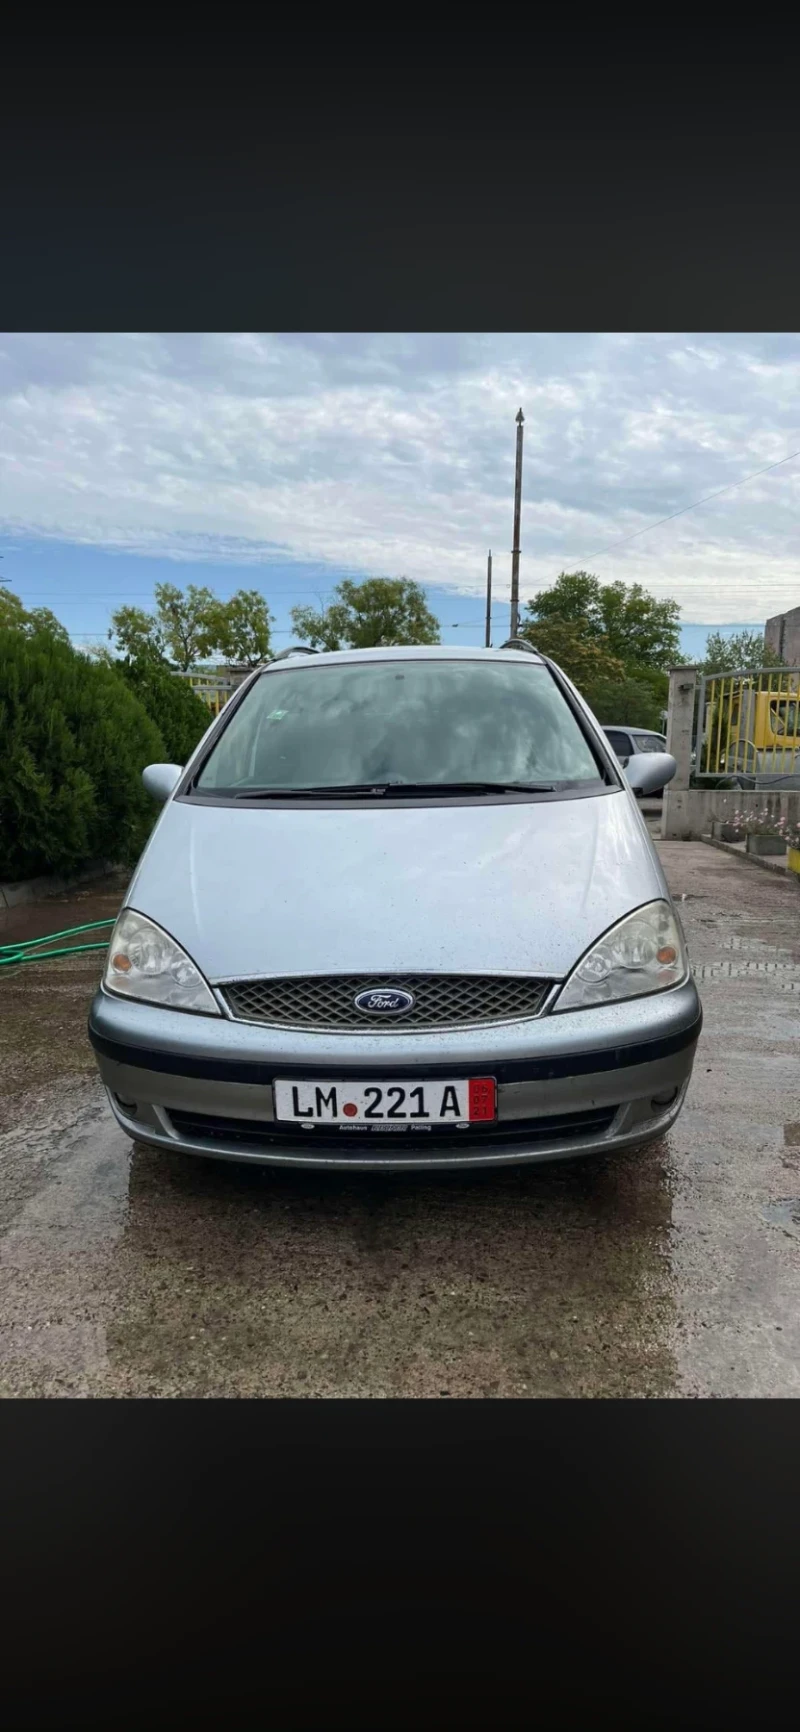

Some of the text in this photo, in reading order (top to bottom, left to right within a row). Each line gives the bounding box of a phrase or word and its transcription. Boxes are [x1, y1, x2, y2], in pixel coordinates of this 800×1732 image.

[367, 994, 400, 1008] Ford
[292, 1085, 462, 1118] LM 221 A
[473, 1106, 488, 1116] 21
